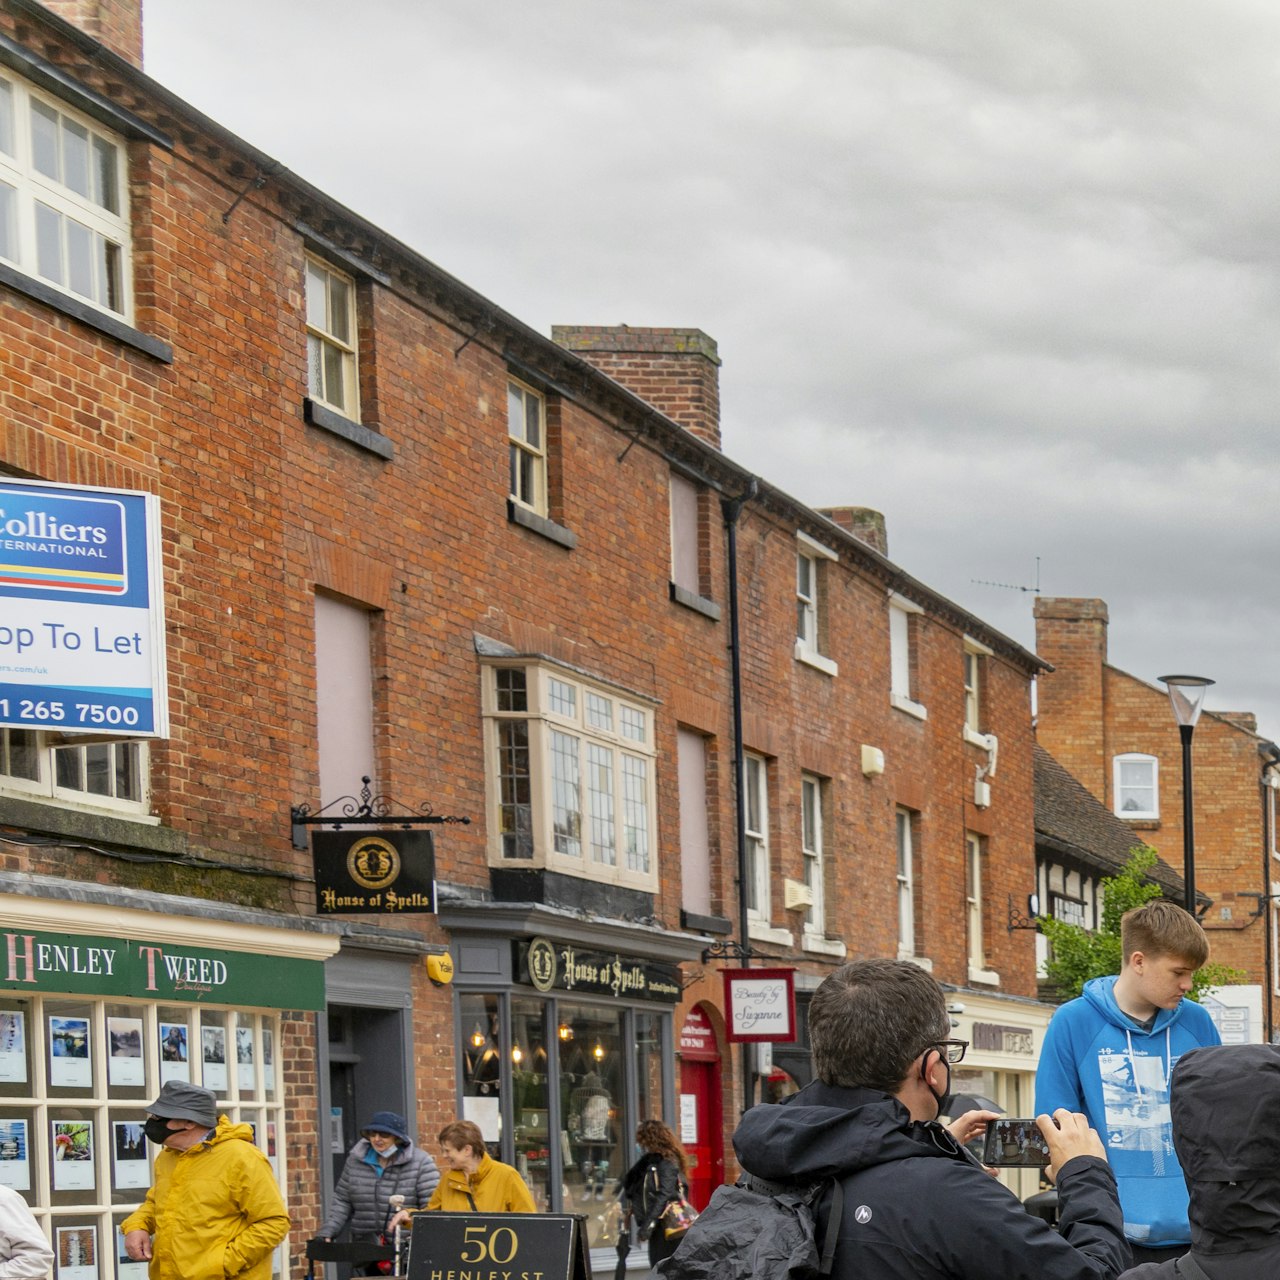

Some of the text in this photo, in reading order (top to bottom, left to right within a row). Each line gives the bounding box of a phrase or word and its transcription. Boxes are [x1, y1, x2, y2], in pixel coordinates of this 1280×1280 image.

[0, 509, 107, 544] olliers
[43, 622, 81, 650] To
[94, 626, 142, 655] Let
[19, 699, 65, 721] 265
[76, 703, 139, 726] 7500
[320, 886, 429, 913] House of Spells
[3, 933, 228, 991] HENLEY TWEED
[561, 945, 645, 998] House of Spells
[734, 986, 784, 1005] Beauty by
[734, 1006, 784, 1030] Suzanne
[460, 1224, 519, 1264] 50
